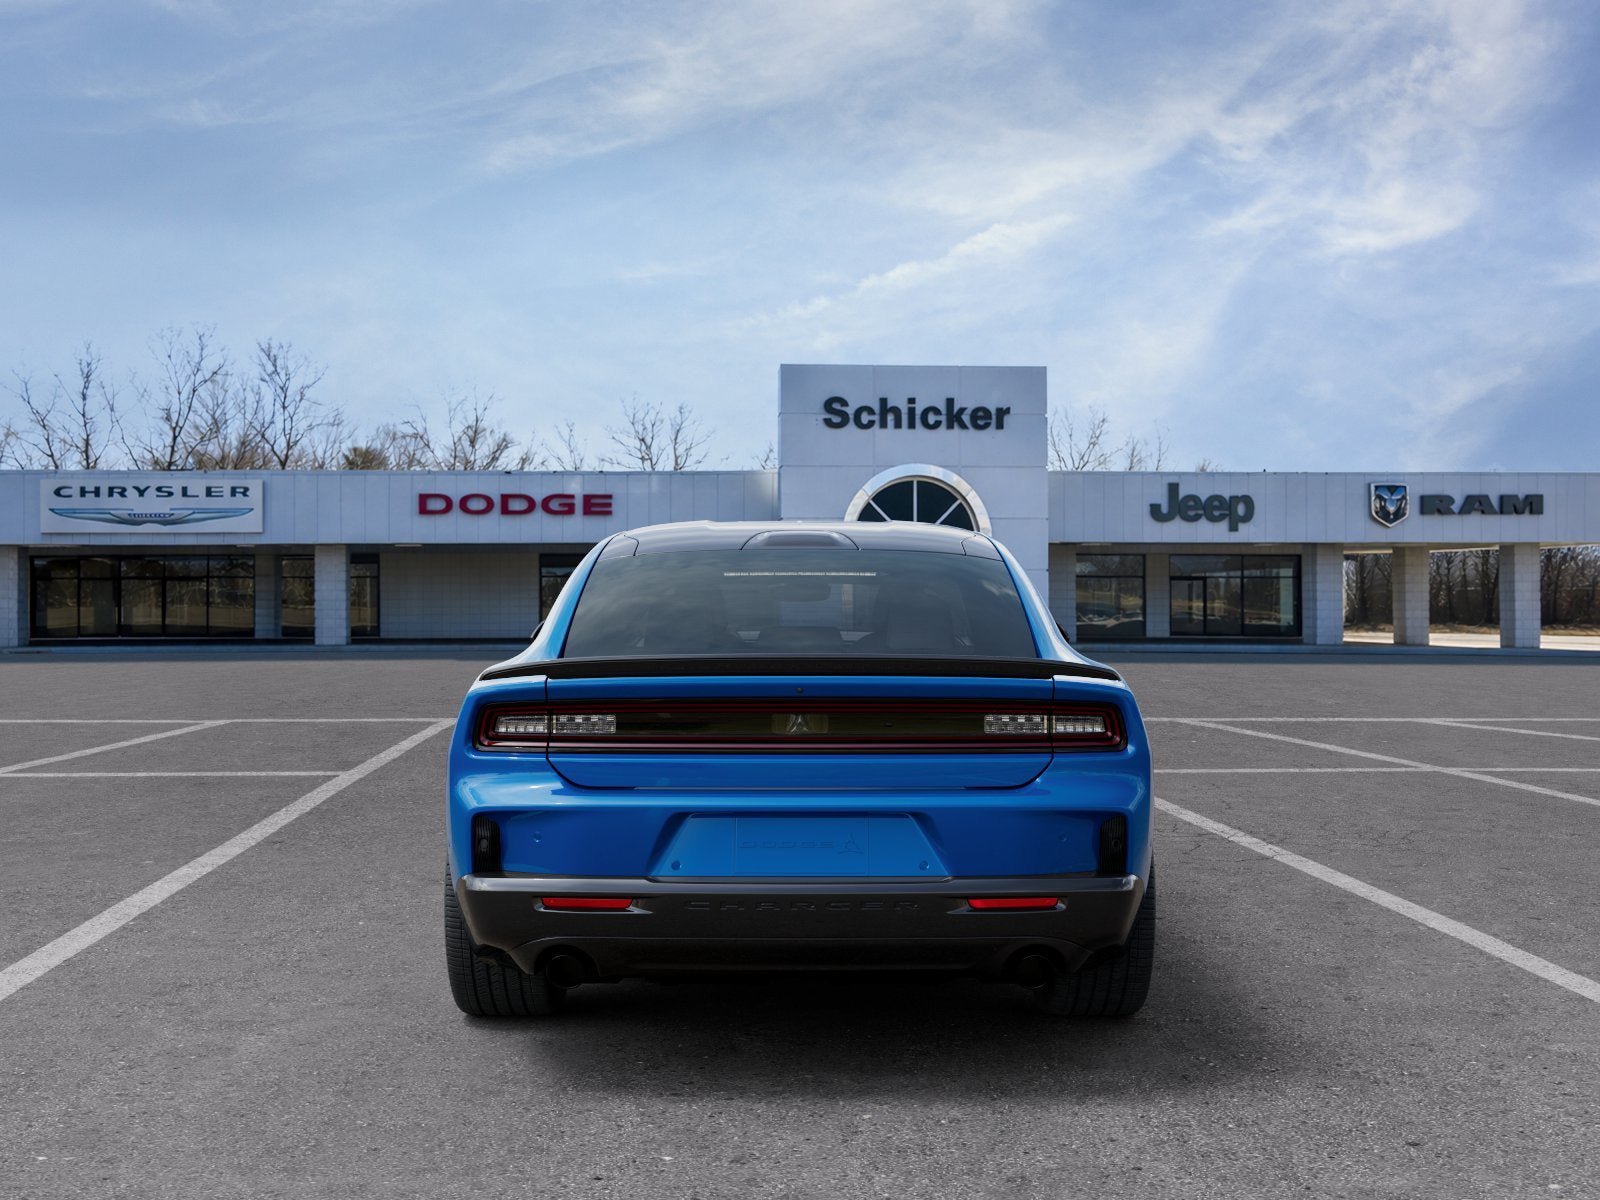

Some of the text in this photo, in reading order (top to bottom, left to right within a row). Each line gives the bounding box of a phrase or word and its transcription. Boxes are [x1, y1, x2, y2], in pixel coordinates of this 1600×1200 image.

[823, 396, 1011, 430] Schicker
[53, 486, 250, 498] CHRYSLER
[418, 493, 613, 516] DODGE
[1149, 482, 1255, 532] Jeep
[1420, 494, 1544, 516] RAM
[739, 839, 835, 849] DODGE
[685, 899, 921, 911] CHARGER
